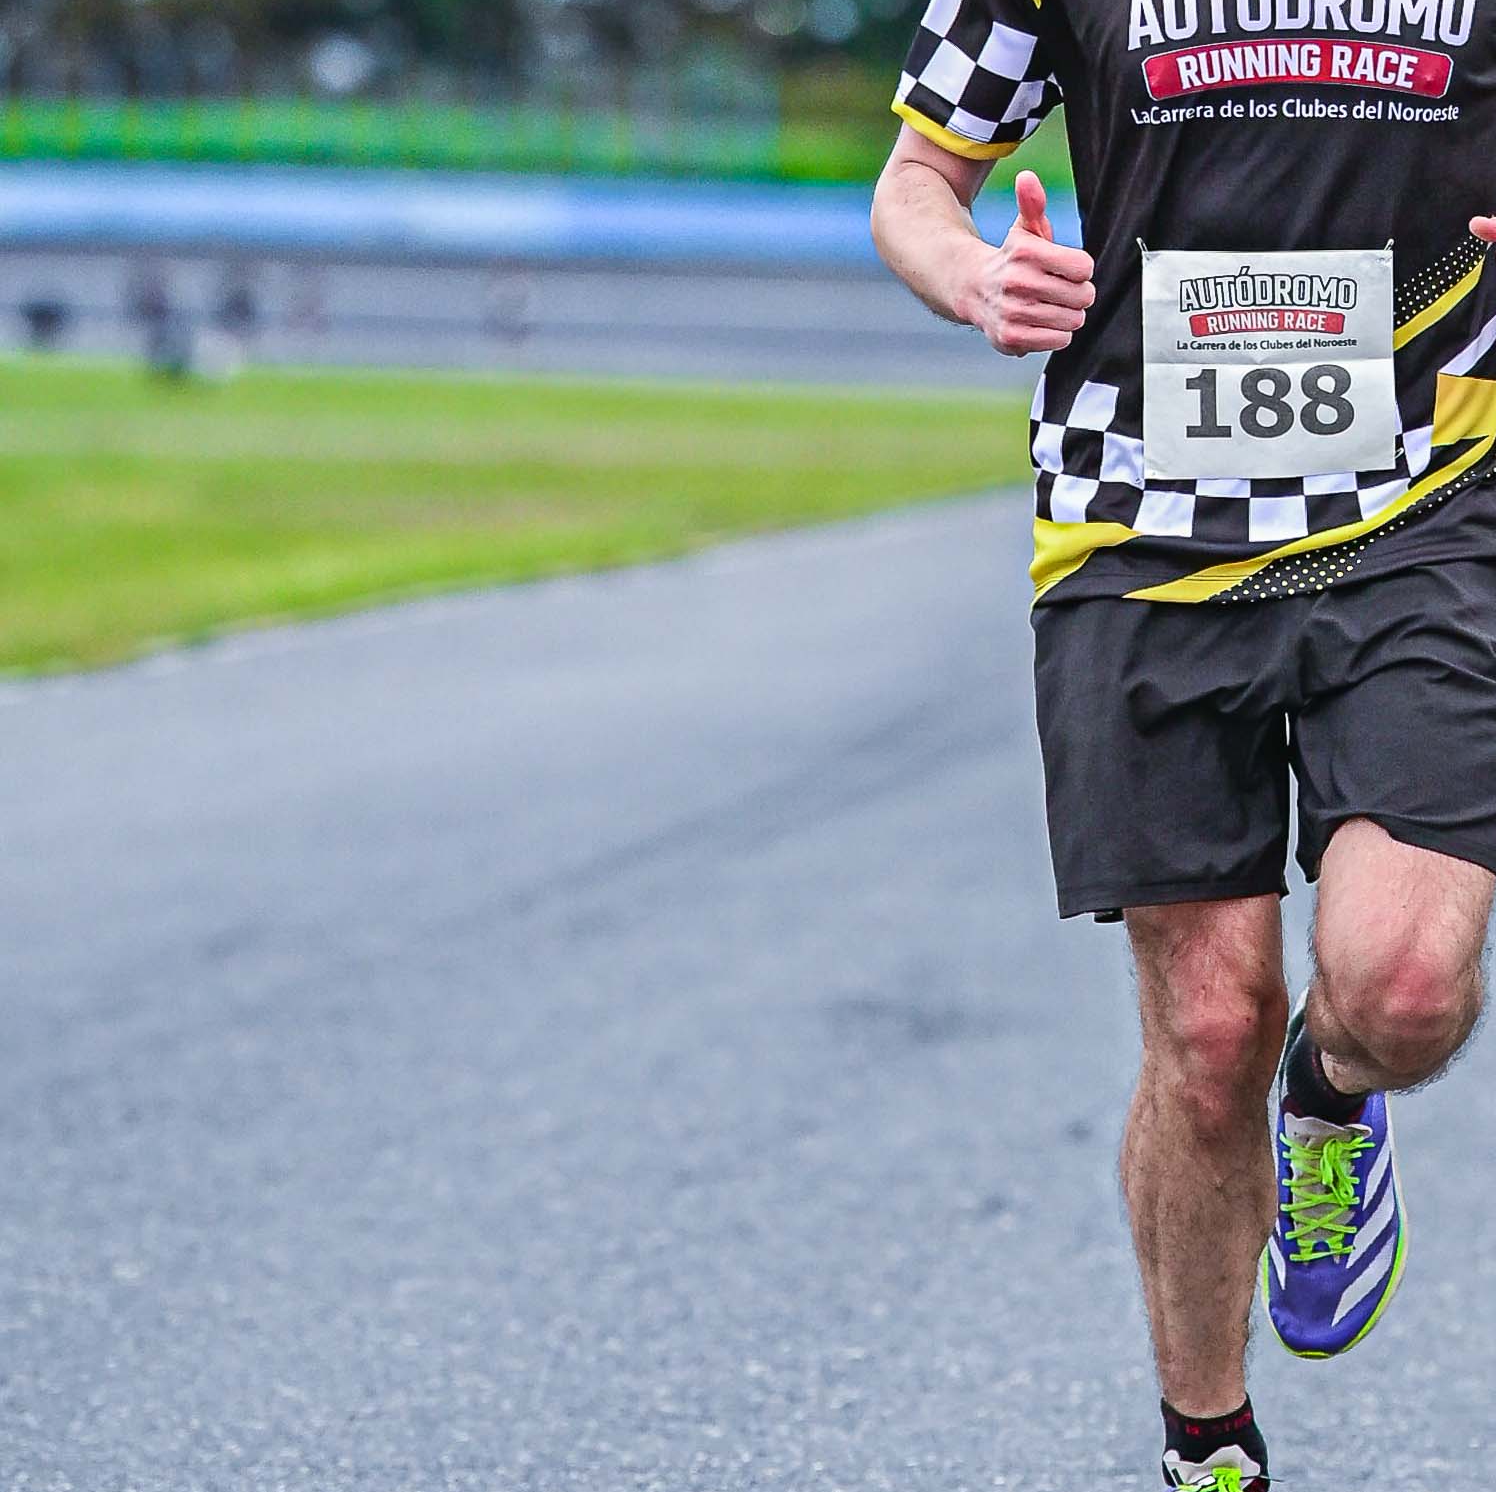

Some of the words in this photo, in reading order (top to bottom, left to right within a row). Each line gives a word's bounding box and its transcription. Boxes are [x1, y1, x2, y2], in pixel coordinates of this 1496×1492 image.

[1176, 43, 1321, 90] RUNNING
[1330, 45, 1419, 89] RACE
[1219, 99, 1244, 119] de
[1249, 100, 1277, 119] los
[1282, 98, 1347, 119] Clubes
[1353, 100, 1382, 120] del
[1388, 101, 1460, 122] Noroeste
[1179, 265, 1358, 313] AUTÓDROMO
[1206, 312, 1279, 334] RUNNING
[1284, 312, 1327, 332] RACE
[1176, 340, 1188, 350] La
[1190, 340, 1226, 351] Carrera
[1228, 340, 1242, 350] de
[1243, 340, 1258, 350] los
[1260, 339, 1294, 350] Clubes
[1296, 338, 1312, 349] del
[1313, 338, 1358, 349] Noroeste
[1185, 364, 1355, 439] 188
